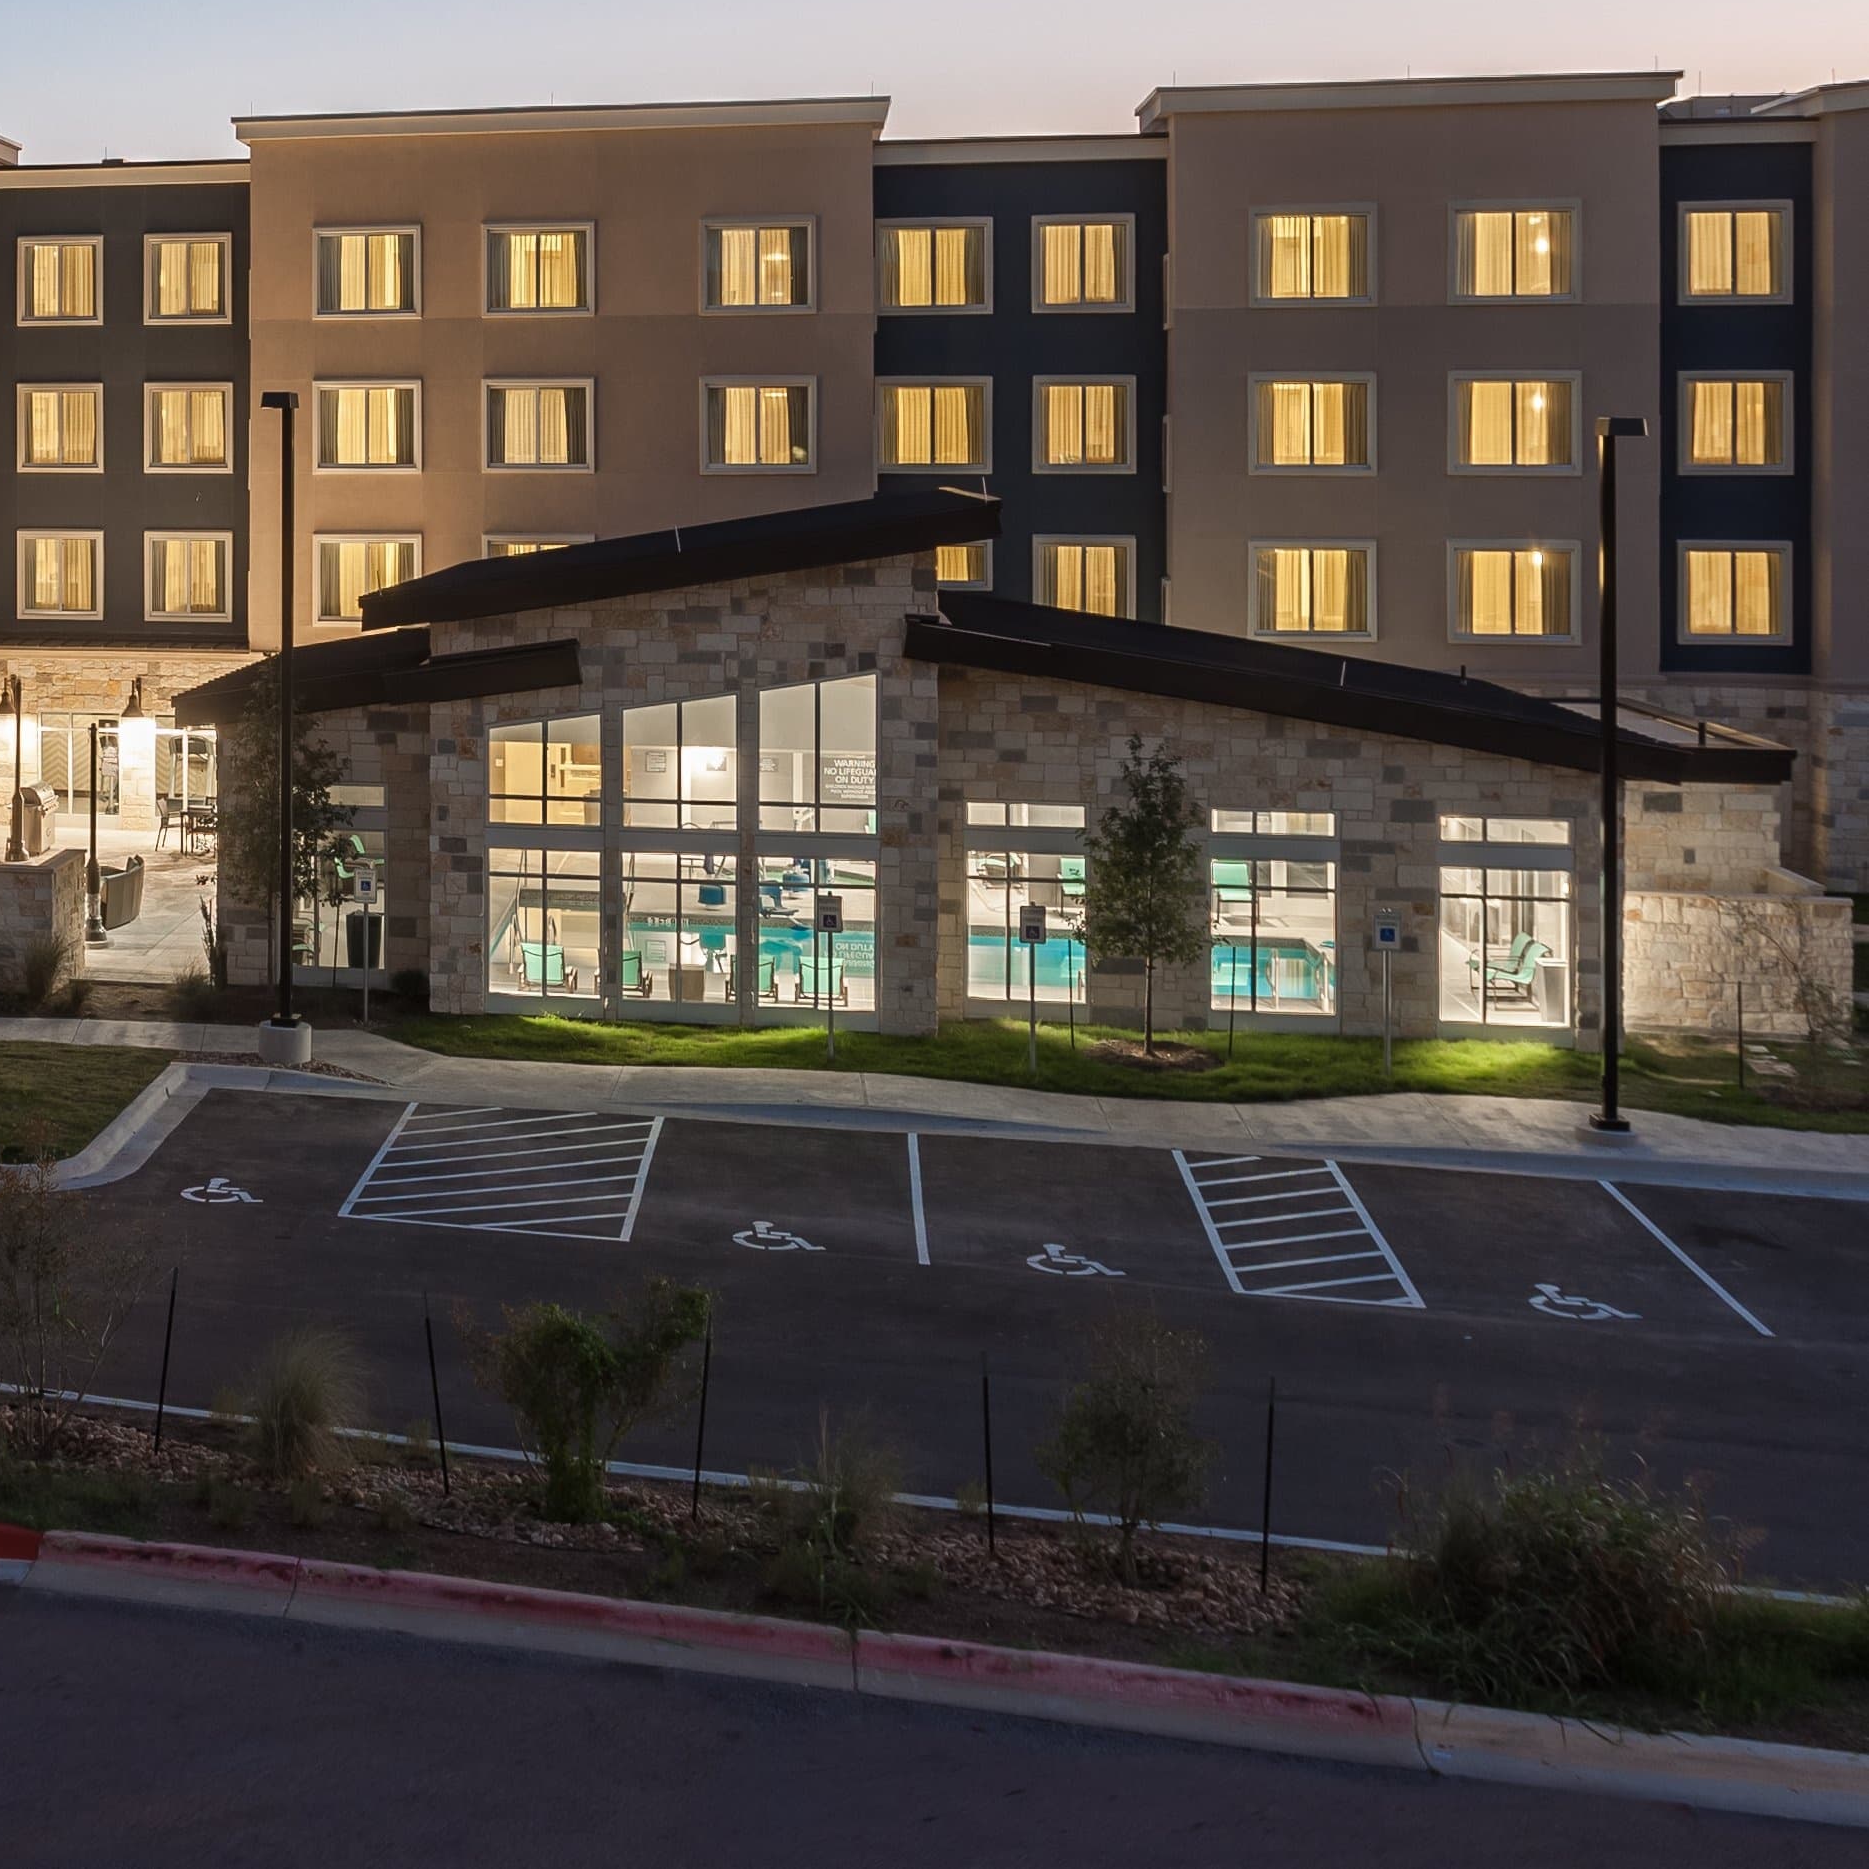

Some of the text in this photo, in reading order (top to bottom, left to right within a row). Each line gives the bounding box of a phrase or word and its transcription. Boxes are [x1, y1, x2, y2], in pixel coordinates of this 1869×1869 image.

[834, 759, 876, 769] WARNING
[824, 767, 877, 777] NO LIFEGUA
[835, 775, 875, 785] ON DUTY
